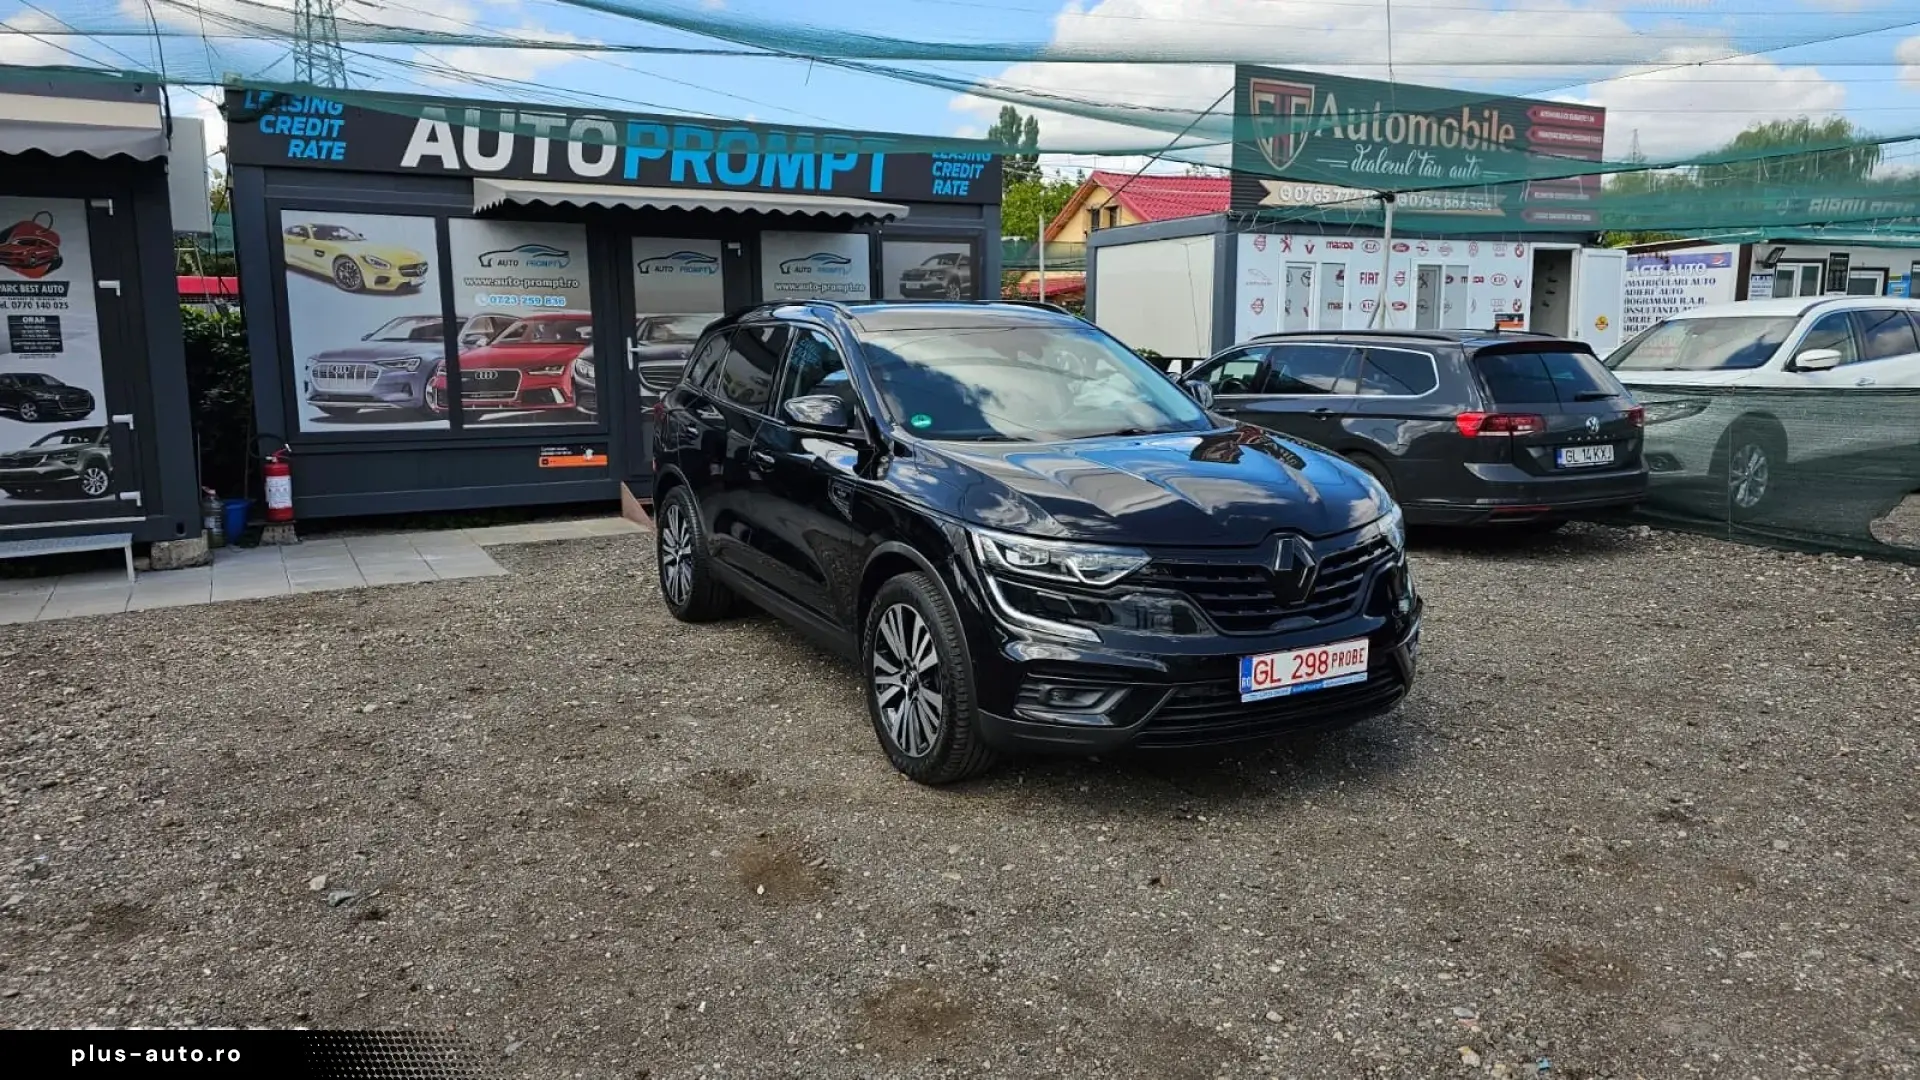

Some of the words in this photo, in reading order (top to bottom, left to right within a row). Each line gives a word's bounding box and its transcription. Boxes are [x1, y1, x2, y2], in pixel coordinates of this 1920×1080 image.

[259, 114, 345, 138] CREDIT
[1314, 91, 1516, 152] Automobile
[287, 138, 347, 161] RATE
[931, 161, 985, 179] CREDIT
[1449, 154, 1484, 180] auto
[932, 178, 970, 197] RATE
[1294, 186, 1331, 203] 0765
[1326, 241, 1354, 250] mazda
[497, 259, 519, 267] AUTO
[1631, 264, 1664, 277] ACTE
[1668, 262, 1708, 276] AUTO
[464, 276, 580, 289] www.auto-prompt.ro
[1360, 271, 1379, 285] FIAT
[1690, 277, 1716, 286] AUTO
[20, 284, 39, 293] BEST
[41, 284, 65, 294] AUTO
[1659, 287, 1684, 295] AUTO
[1565, 449, 1580, 462] GL
[1582, 447, 1592, 461] 14
[1253, 658, 1282, 686] GL
[1291, 650, 1330, 680] 298
[1331, 647, 1366, 670] PROBE
